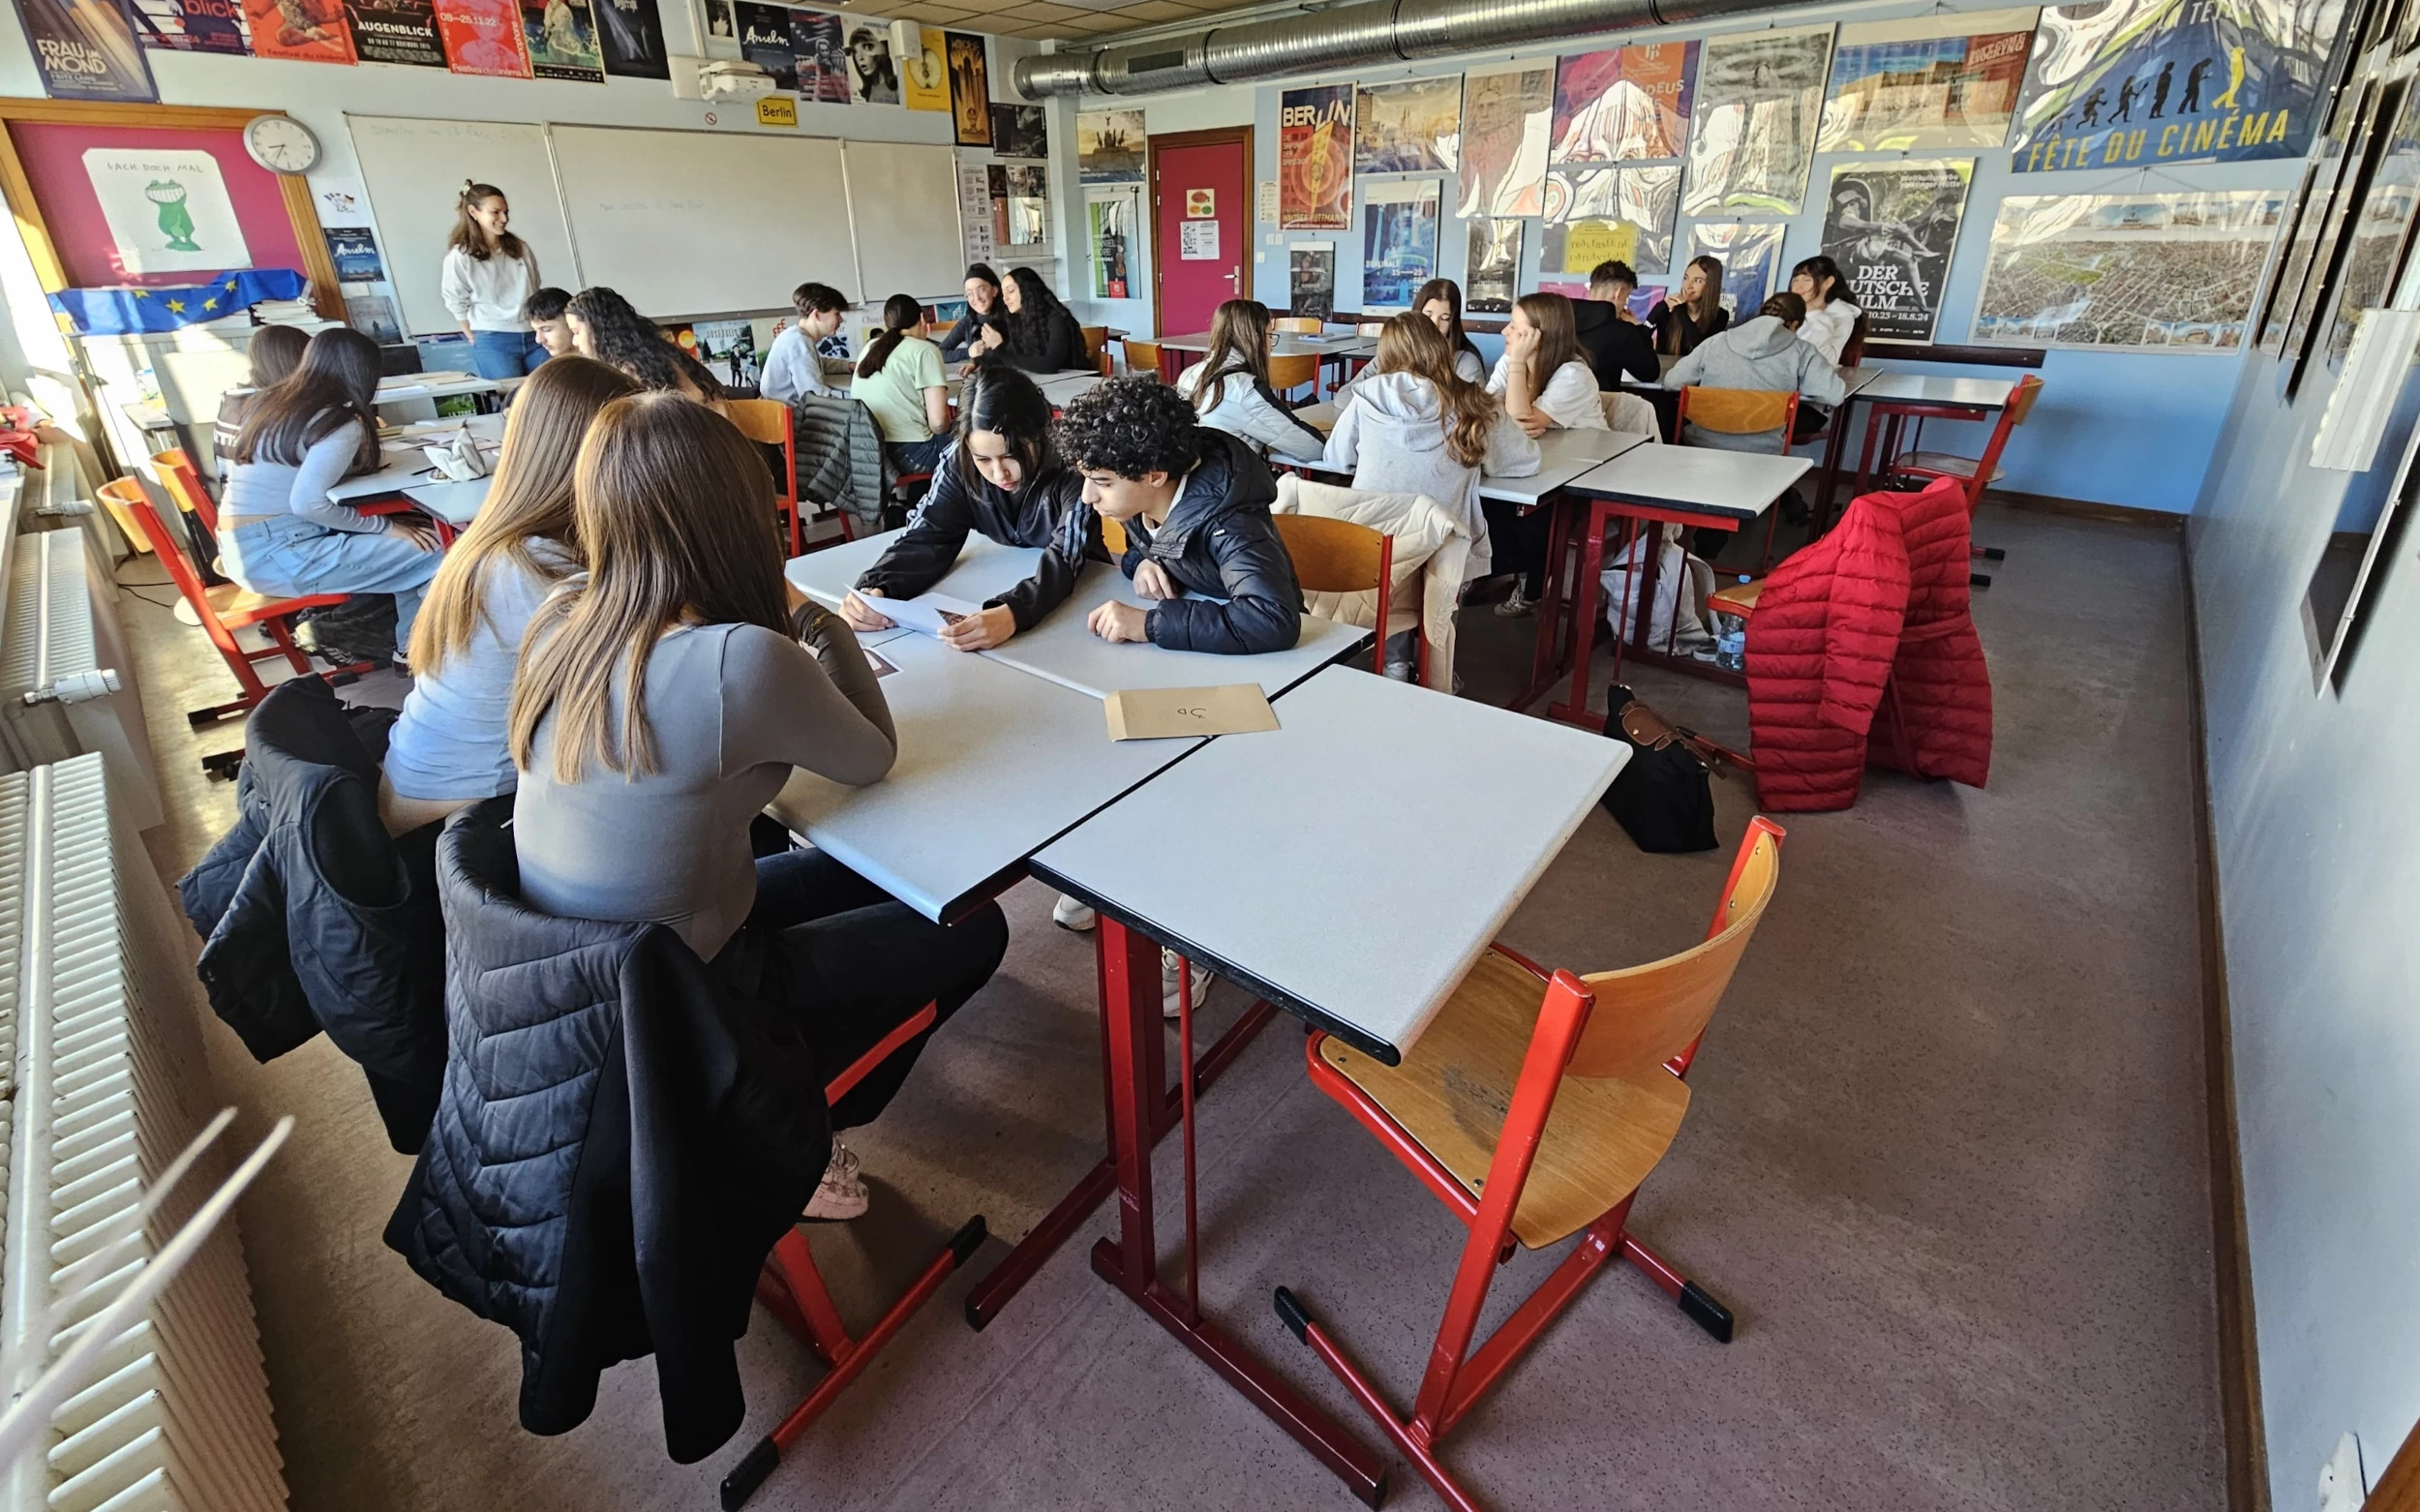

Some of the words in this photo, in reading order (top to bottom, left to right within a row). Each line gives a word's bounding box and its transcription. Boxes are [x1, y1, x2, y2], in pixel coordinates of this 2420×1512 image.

[358, 21, 434, 38] AUGENBLICK
[741, 25, 790, 47] Anselm
[36, 39, 85, 58] FRAU
[45, 56, 106, 75] MOND
[762, 105, 792, 118] Berlin
[1283, 99, 1351, 133] BERLIN
[2027, 130, 2097, 172] FÊTE
[2102, 128, 2148, 165] DU
[2157, 107, 2289, 157] CINÉMA
[106, 162, 137, 171] LACH
[142, 164, 170, 172] DOCH
[177, 164, 205, 173] MAL
[334, 242, 376, 257] Anselm
[1856, 264, 1899, 281] DER
[1847, 279, 1930, 297] UTSCHE
[1897, 313, 1929, 321] 18.8.24
